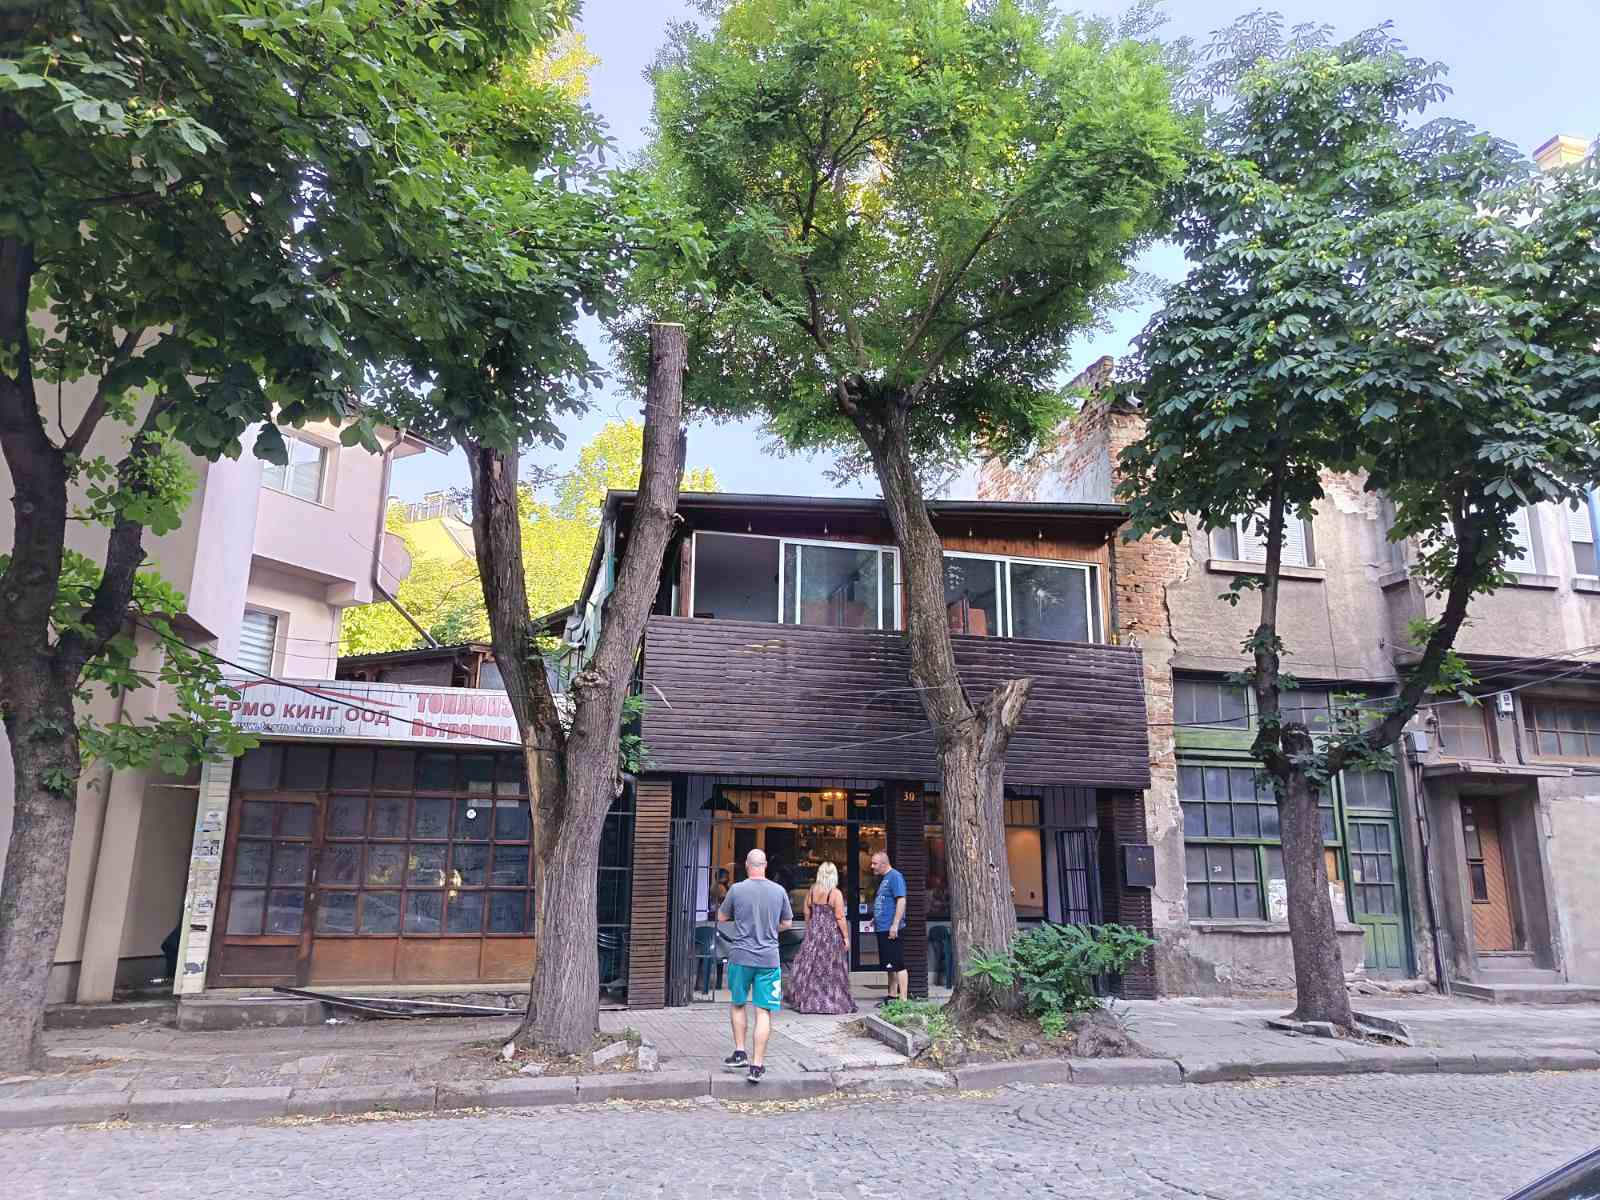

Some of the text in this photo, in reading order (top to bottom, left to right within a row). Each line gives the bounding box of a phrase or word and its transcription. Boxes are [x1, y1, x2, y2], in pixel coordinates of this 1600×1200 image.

[207, 699, 389, 726] ЕРМО КИНГ ООД
